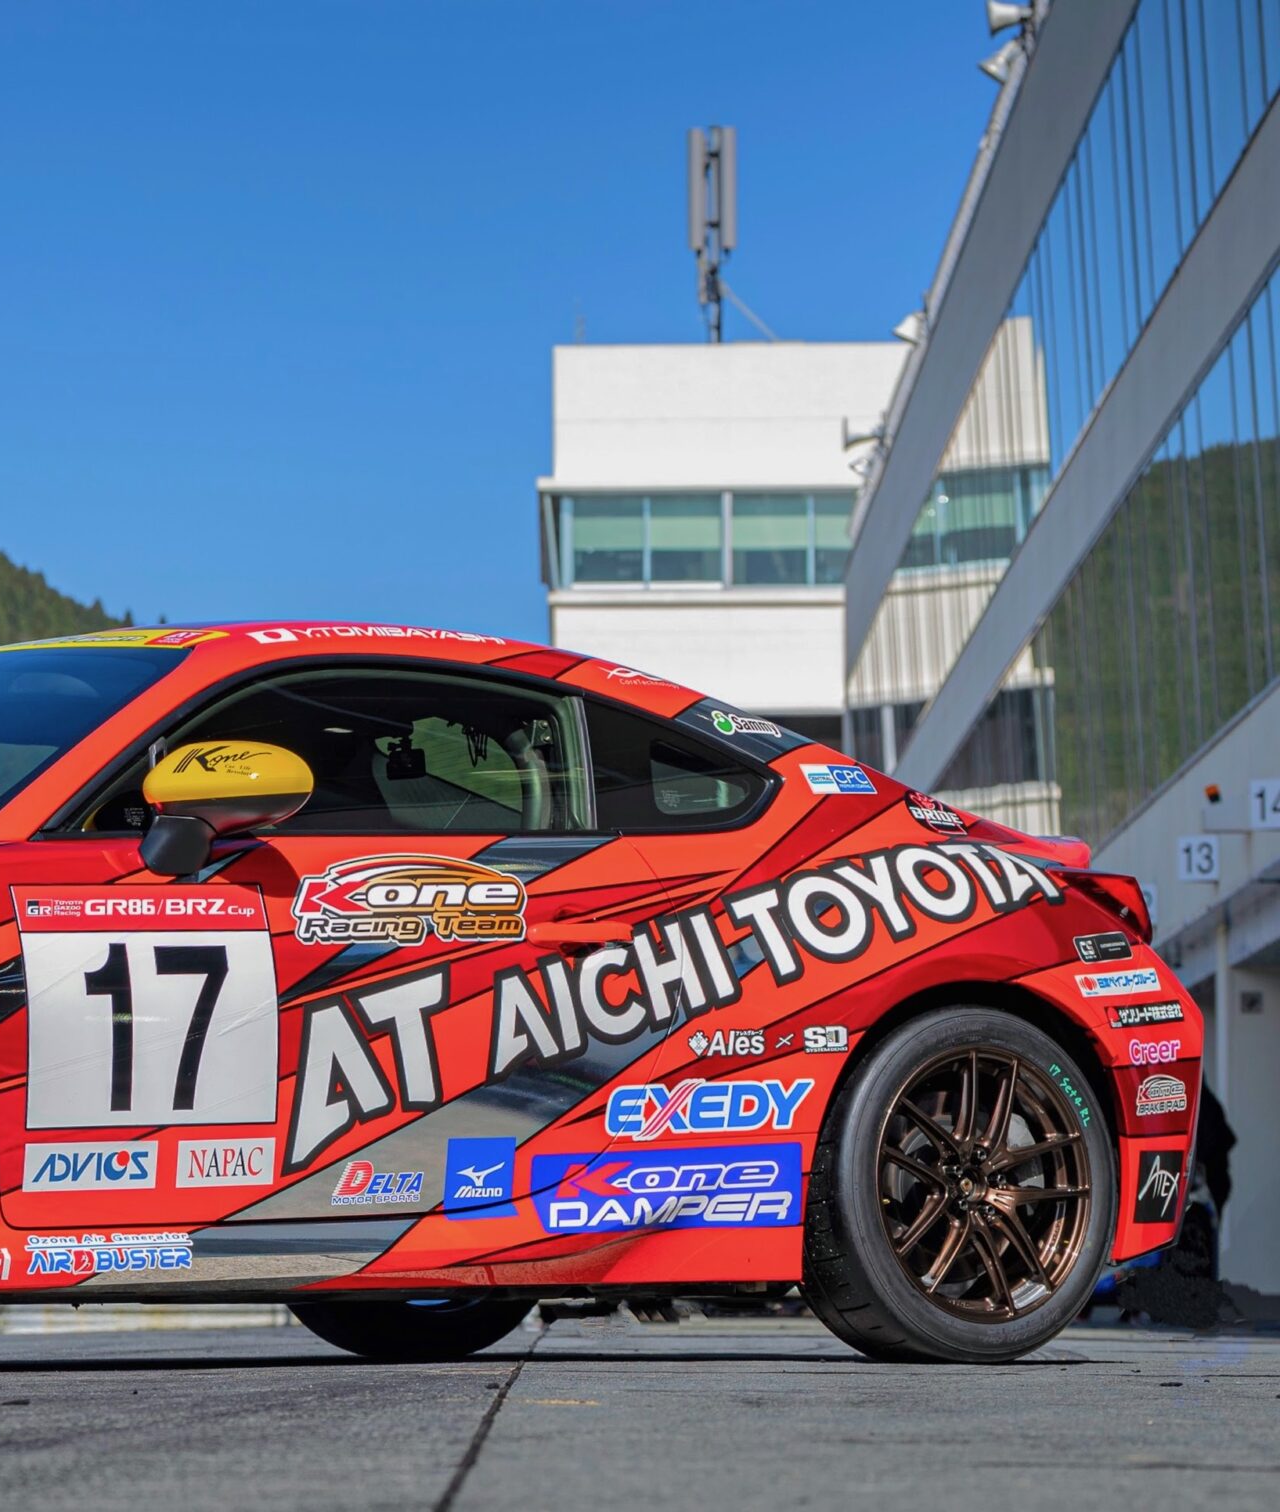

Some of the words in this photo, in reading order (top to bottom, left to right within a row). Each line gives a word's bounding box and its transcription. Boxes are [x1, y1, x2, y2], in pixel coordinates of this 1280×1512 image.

[292, 625, 506, 645] Y.TOMIBAYASHI
[730, 715, 780, 736] Sammy
[832, 769, 870, 785] CPC
[908, 805, 964, 825] BRIDE
[1183, 842, 1214, 874] 13
[27, 905, 52, 915] GR
[227, 905, 255, 917] Cup
[303, 915, 422, 937] Racing
[436, 914, 521, 933] Team
[289, 971, 444, 1167] AT
[494, 914, 737, 1075] AICHI
[731, 843, 1060, 978] TOYOTA
[83, 943, 229, 1112] 17
[707, 1030, 765, 1057] Ales
[803, 1026, 848, 1048] SD
[1129, 1039, 1181, 1065] Creer
[606, 1079, 813, 1140] EXEDY
[1138, 1101, 1164, 1115] BRAKE
[1166, 1099, 1186, 1112] PAD
[31, 1150, 149, 1184] ADVICS
[187, 1146, 264, 1179] NAPAC
[332, 1160, 424, 1197] DELTA
[332, 1195, 372, 1205] MOTOR
[375, 1194, 420, 1203] SPORTS
[549, 1191, 793, 1228] DAMPER
[28, 1236, 76, 1245] Ozone
[83, 1235, 106, 1243] Air
[112, 1233, 189, 1242] Generator
[95, 1248, 192, 1272] BUSTER
